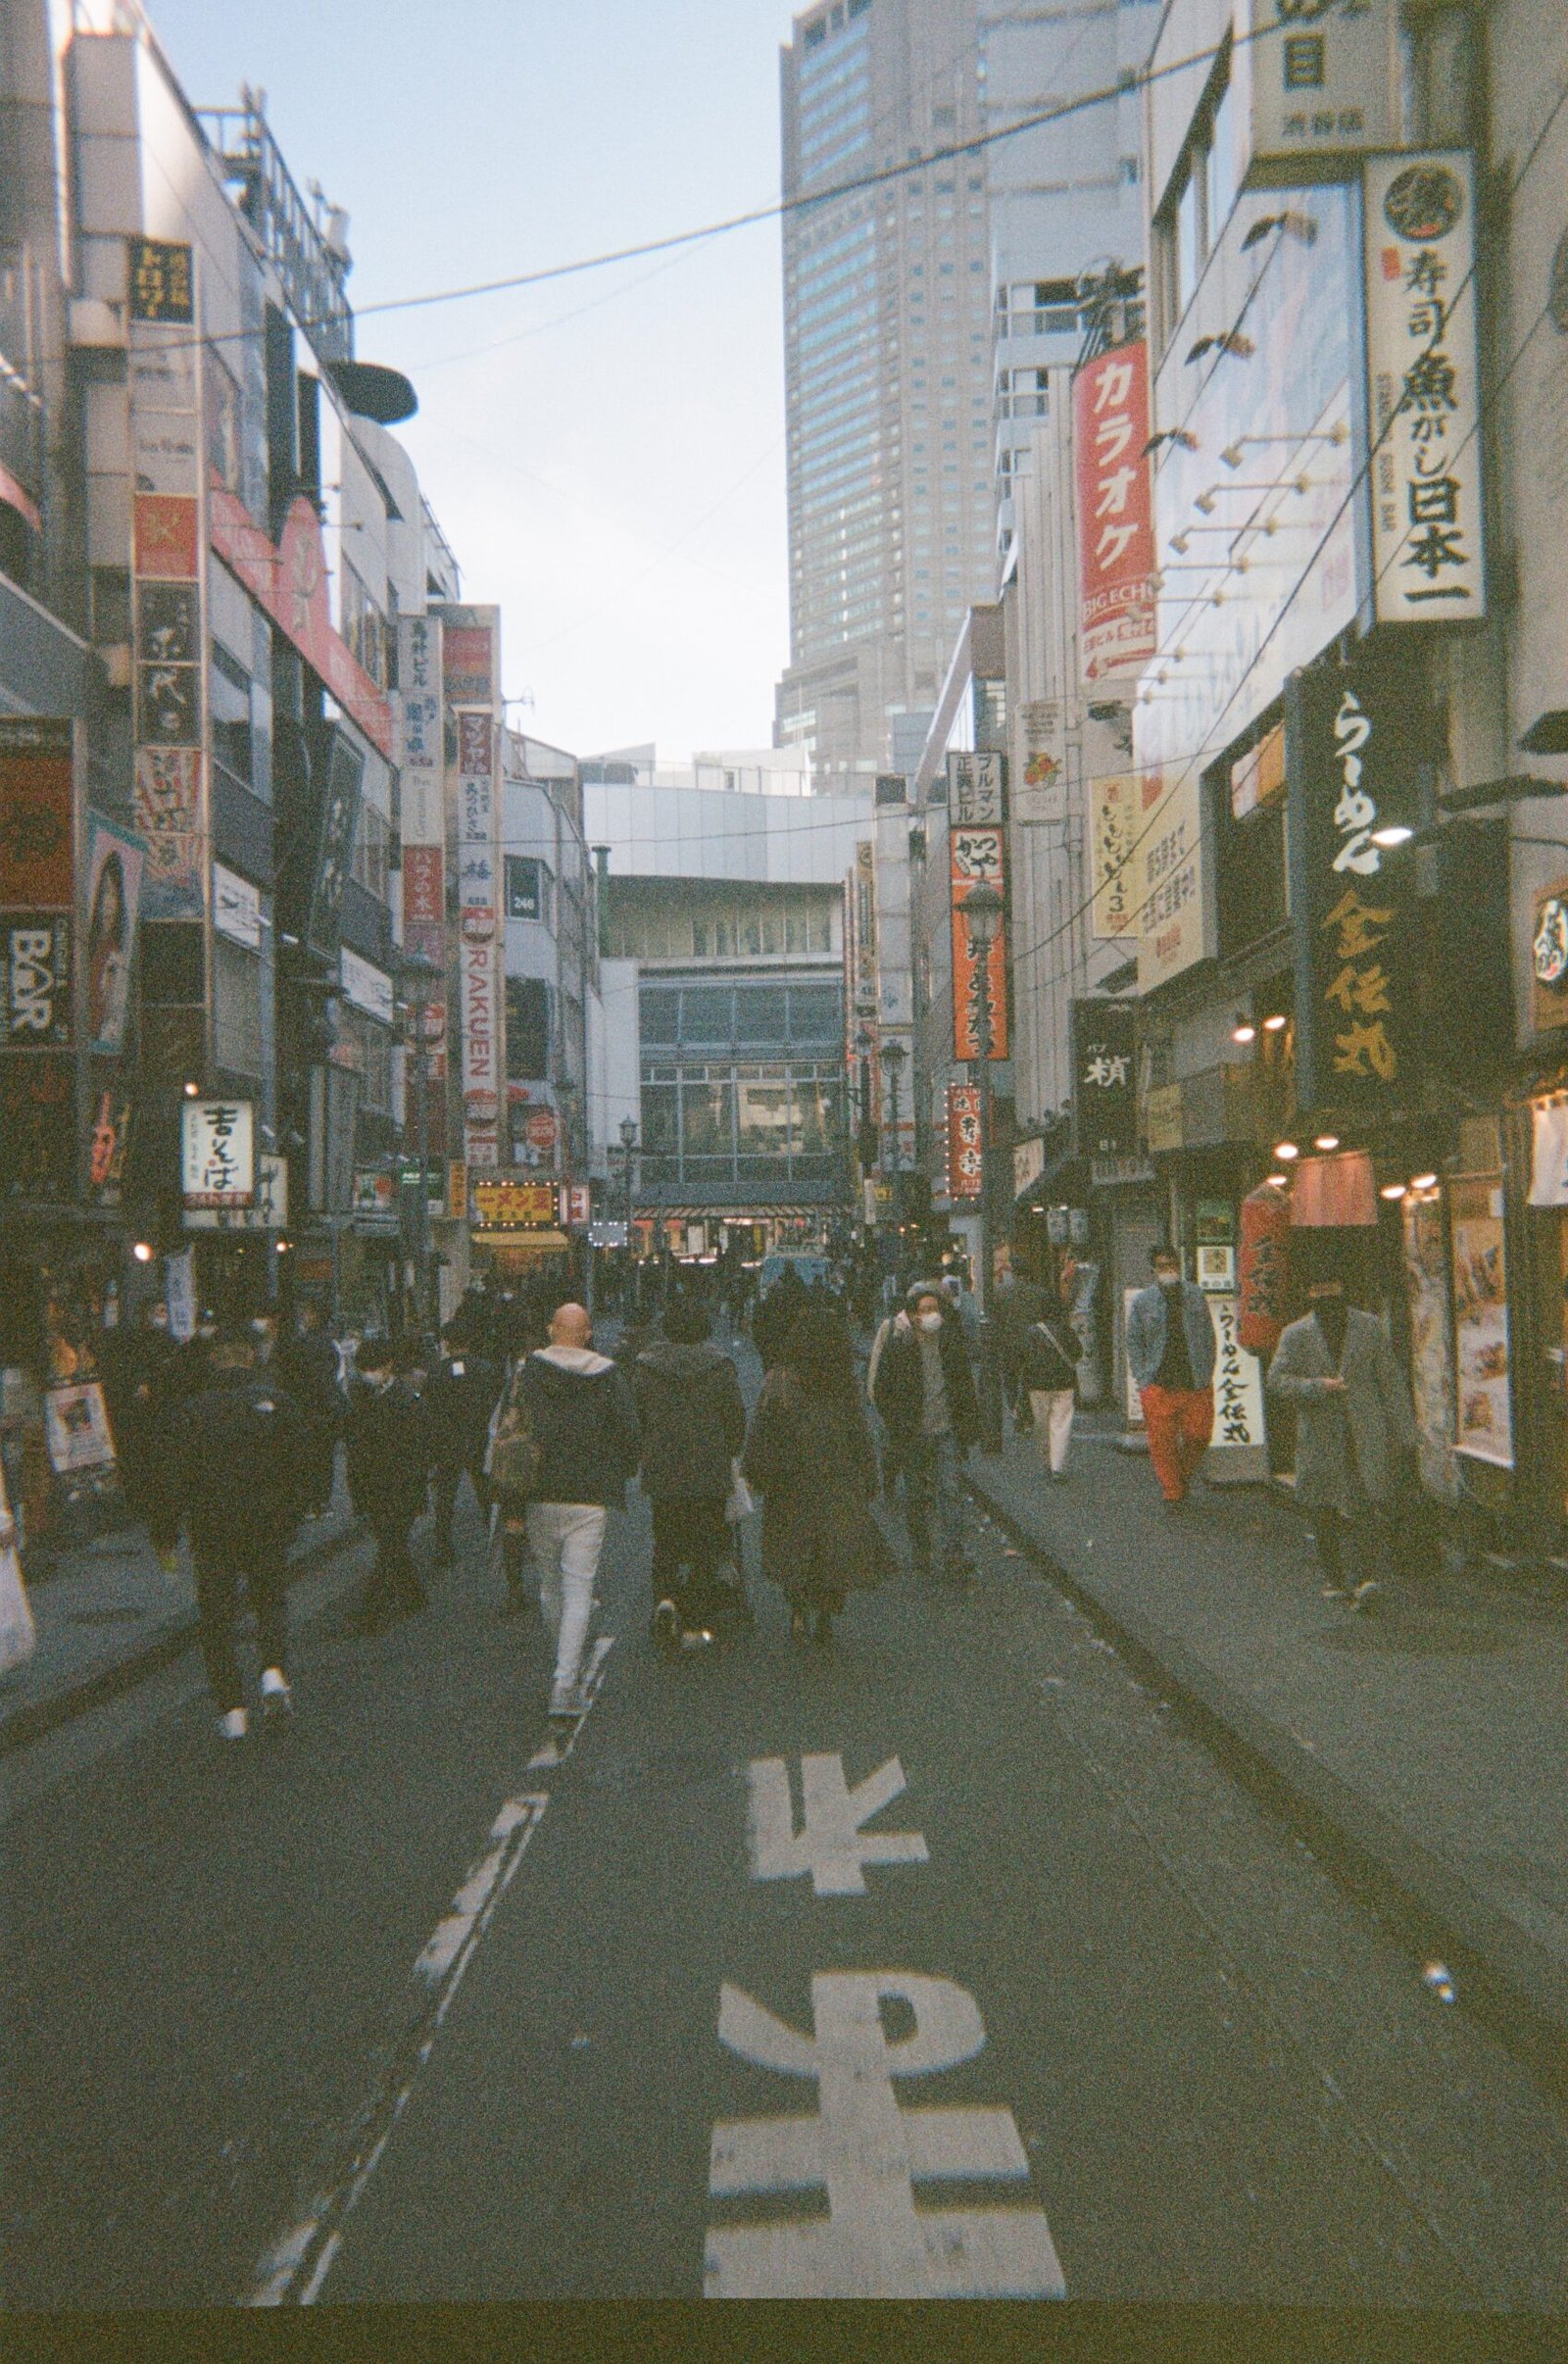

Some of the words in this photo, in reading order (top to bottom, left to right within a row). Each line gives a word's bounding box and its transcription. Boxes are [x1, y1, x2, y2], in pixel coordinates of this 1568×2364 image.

[1094, 361, 1140, 571] カラオケ
[1083, 593, 1108, 619] BIG
[955, 835, 999, 879] かつや
[12, 930, 53, 1030] BAR
[467, 945, 489, 1079] RAKUEN
[203, 1106, 239, 1191] 吉そば
